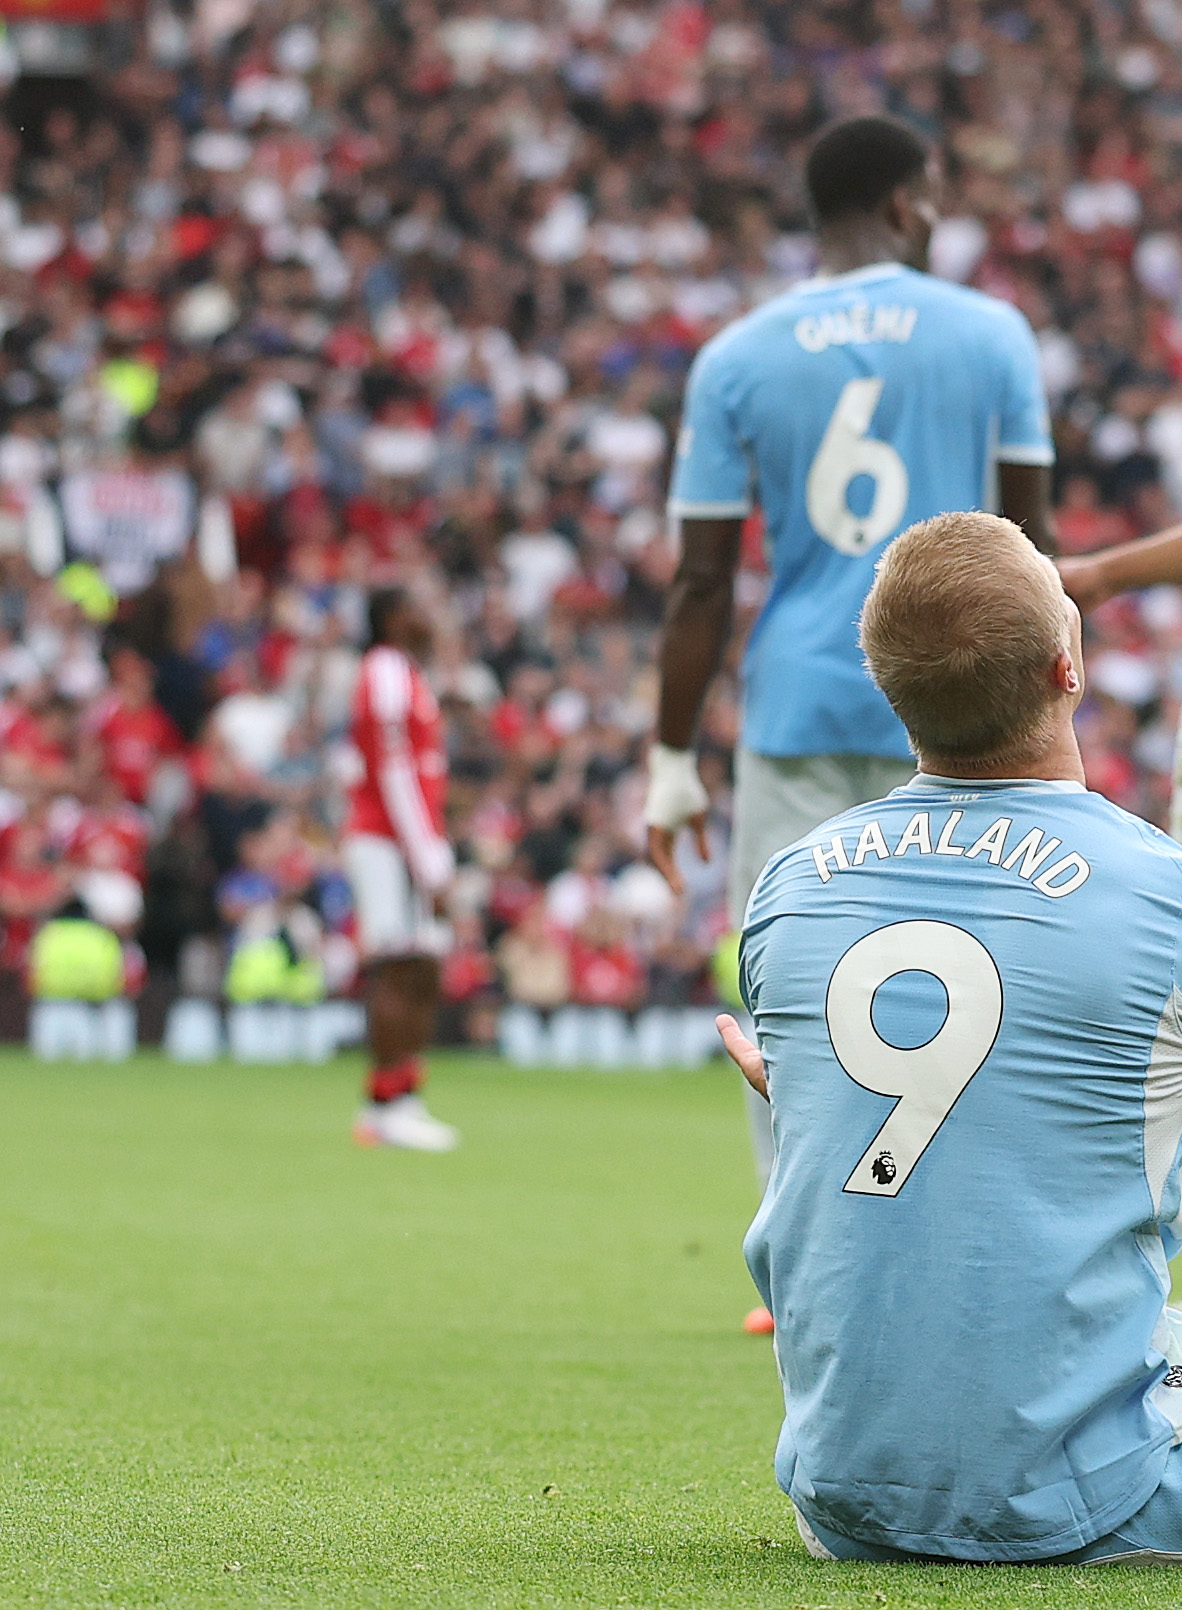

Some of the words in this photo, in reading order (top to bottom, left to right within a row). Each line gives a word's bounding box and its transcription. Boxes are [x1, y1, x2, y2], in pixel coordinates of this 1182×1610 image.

[805, 376, 910, 557] 6
[811, 810, 1091, 899] HAALAND
[825, 918, 1004, 1198] 9
